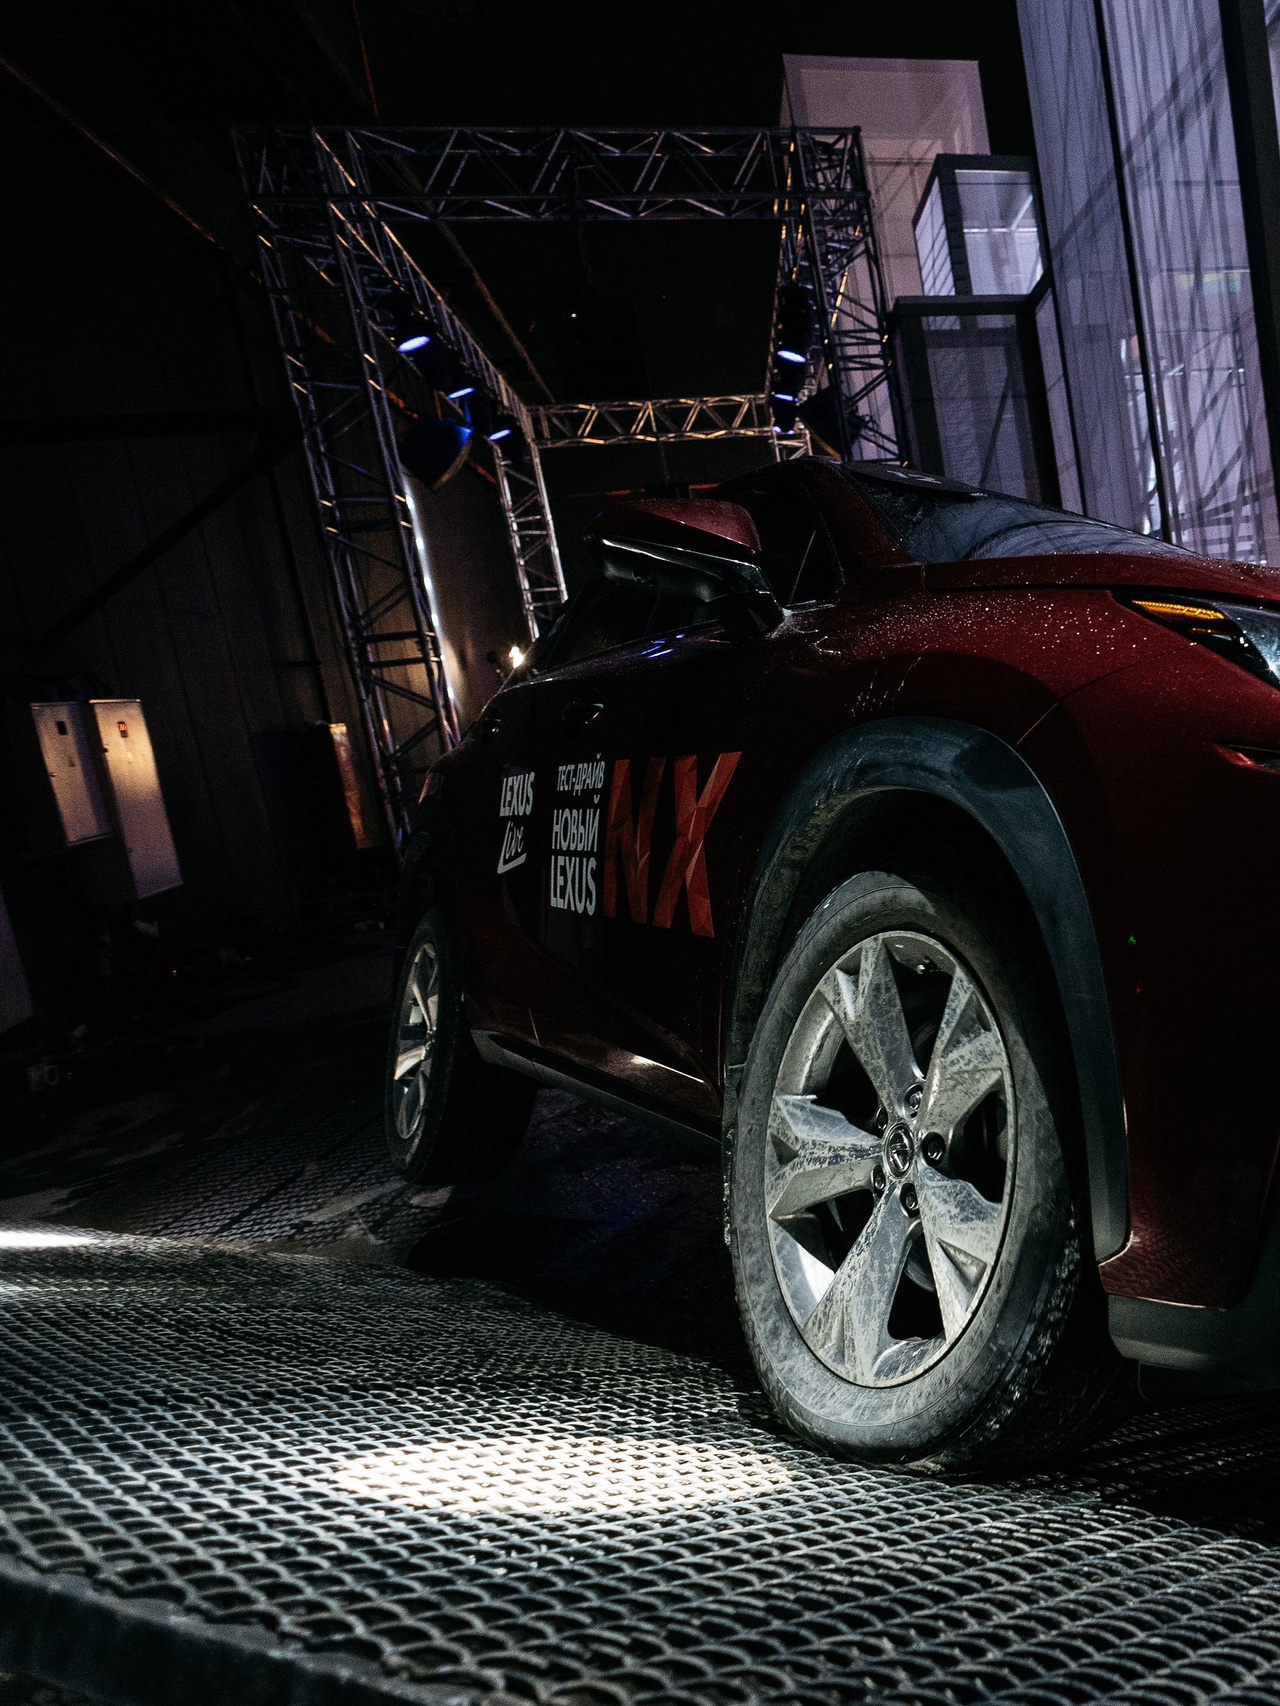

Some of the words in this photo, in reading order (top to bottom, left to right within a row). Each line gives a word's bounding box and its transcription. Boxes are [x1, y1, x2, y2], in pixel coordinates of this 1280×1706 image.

[499, 771, 535, 817] LEXUS
[557, 753, 605, 796] ТЕСТ-ДРАЙВ
[552, 794, 600, 853] НОВЫЙ
[603, 751, 743, 938] NX
[550, 855, 597, 916] LEXUS
